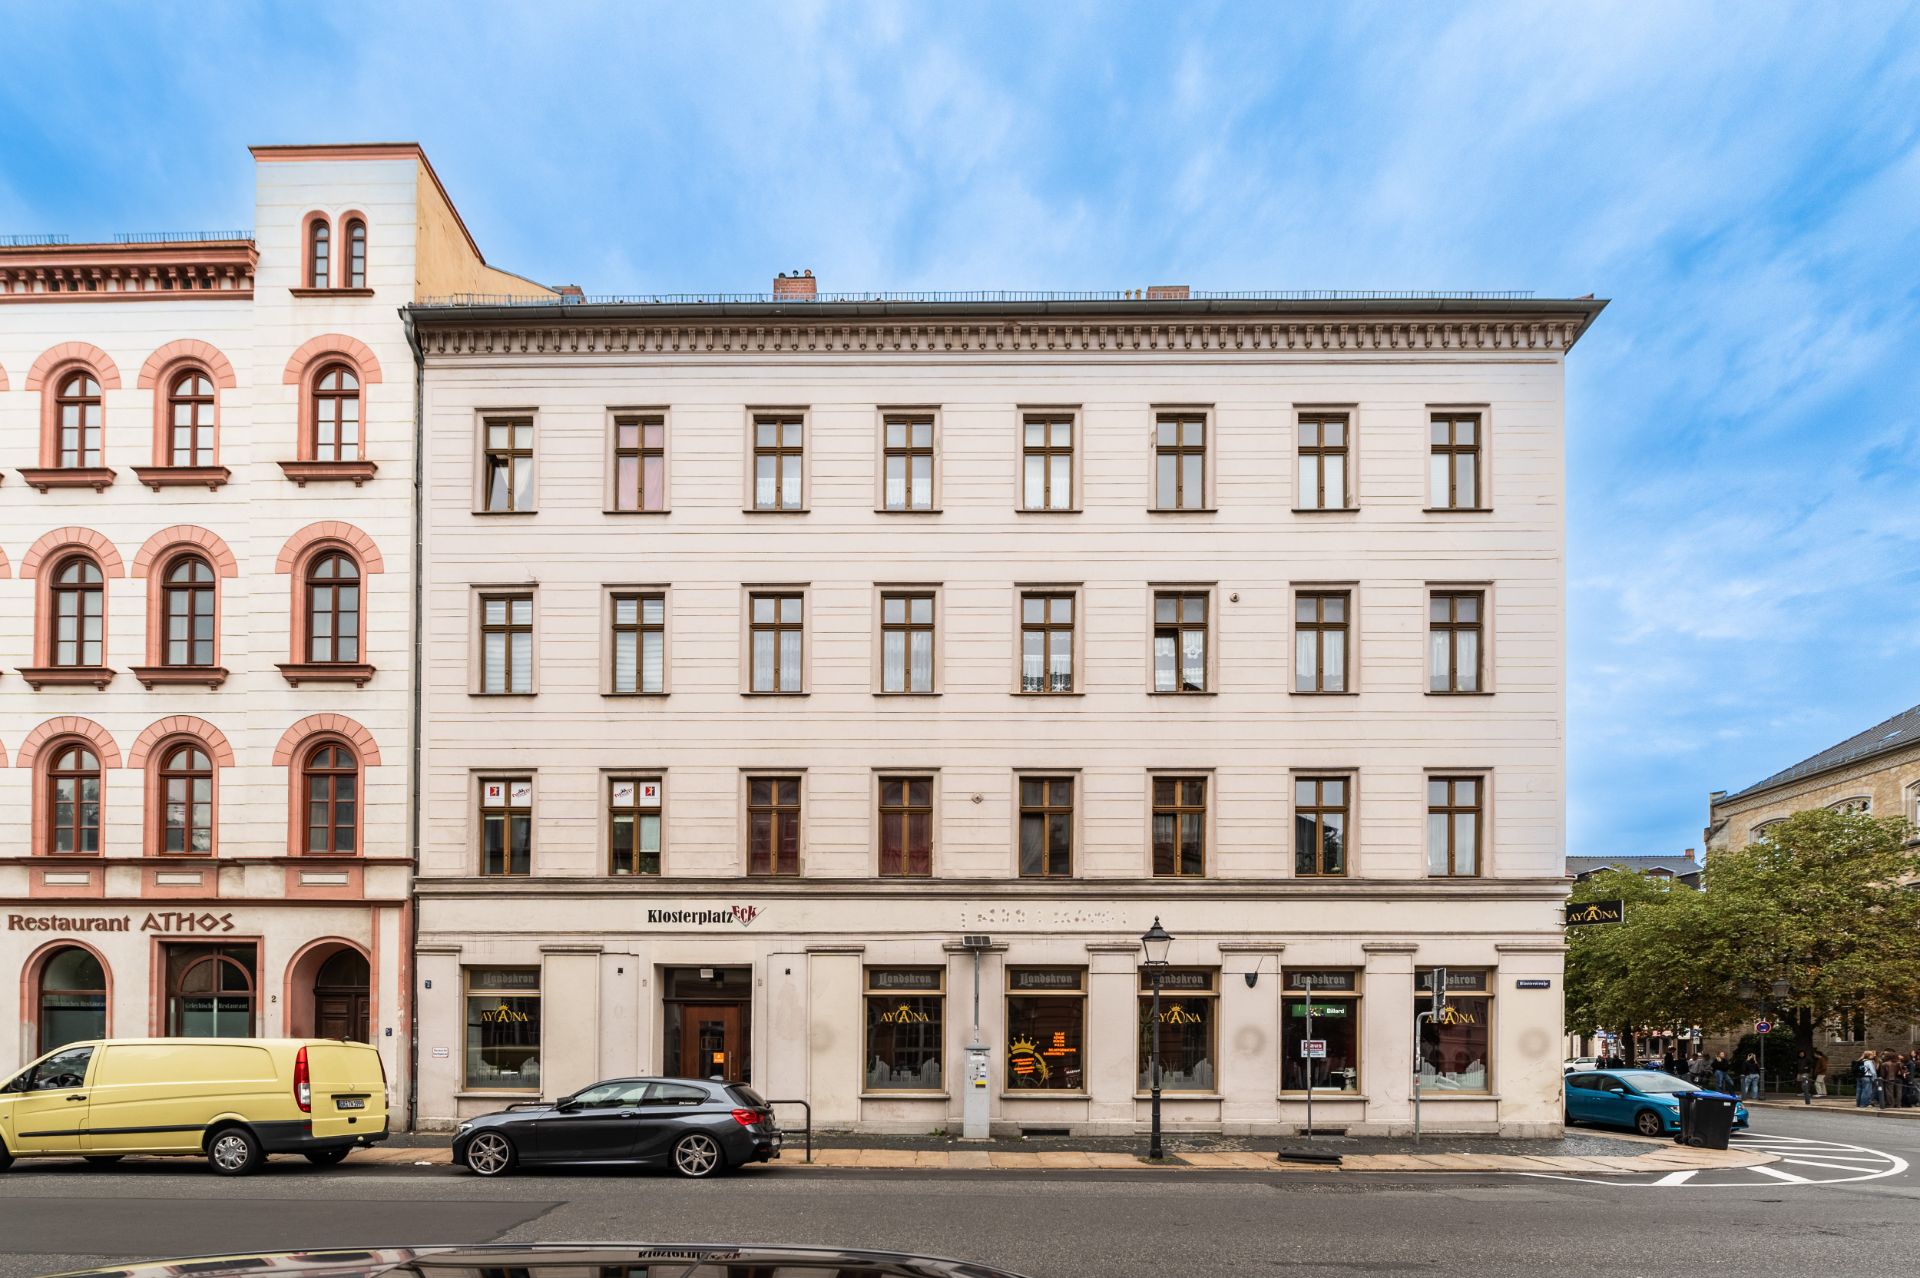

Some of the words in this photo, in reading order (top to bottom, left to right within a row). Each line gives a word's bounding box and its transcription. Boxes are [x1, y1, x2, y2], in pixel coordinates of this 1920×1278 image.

[8, 914, 130, 931] Restaurant
[141, 912, 234, 932] ATHOS
[648, 910, 733, 925] Klosterplatz
[1569, 910, 1619, 921] AYANA
[879, 972, 931, 986] Landskron
[1019, 973, 1072, 986] Landskron
[1151, 974, 1203, 987] andskron
[481, 1010, 528, 1023] AYANA
[880, 1010, 929, 1023] AYANA
[1159, 1011, 1201, 1024] YANA
[1426, 1011, 1475, 1024] AANA
